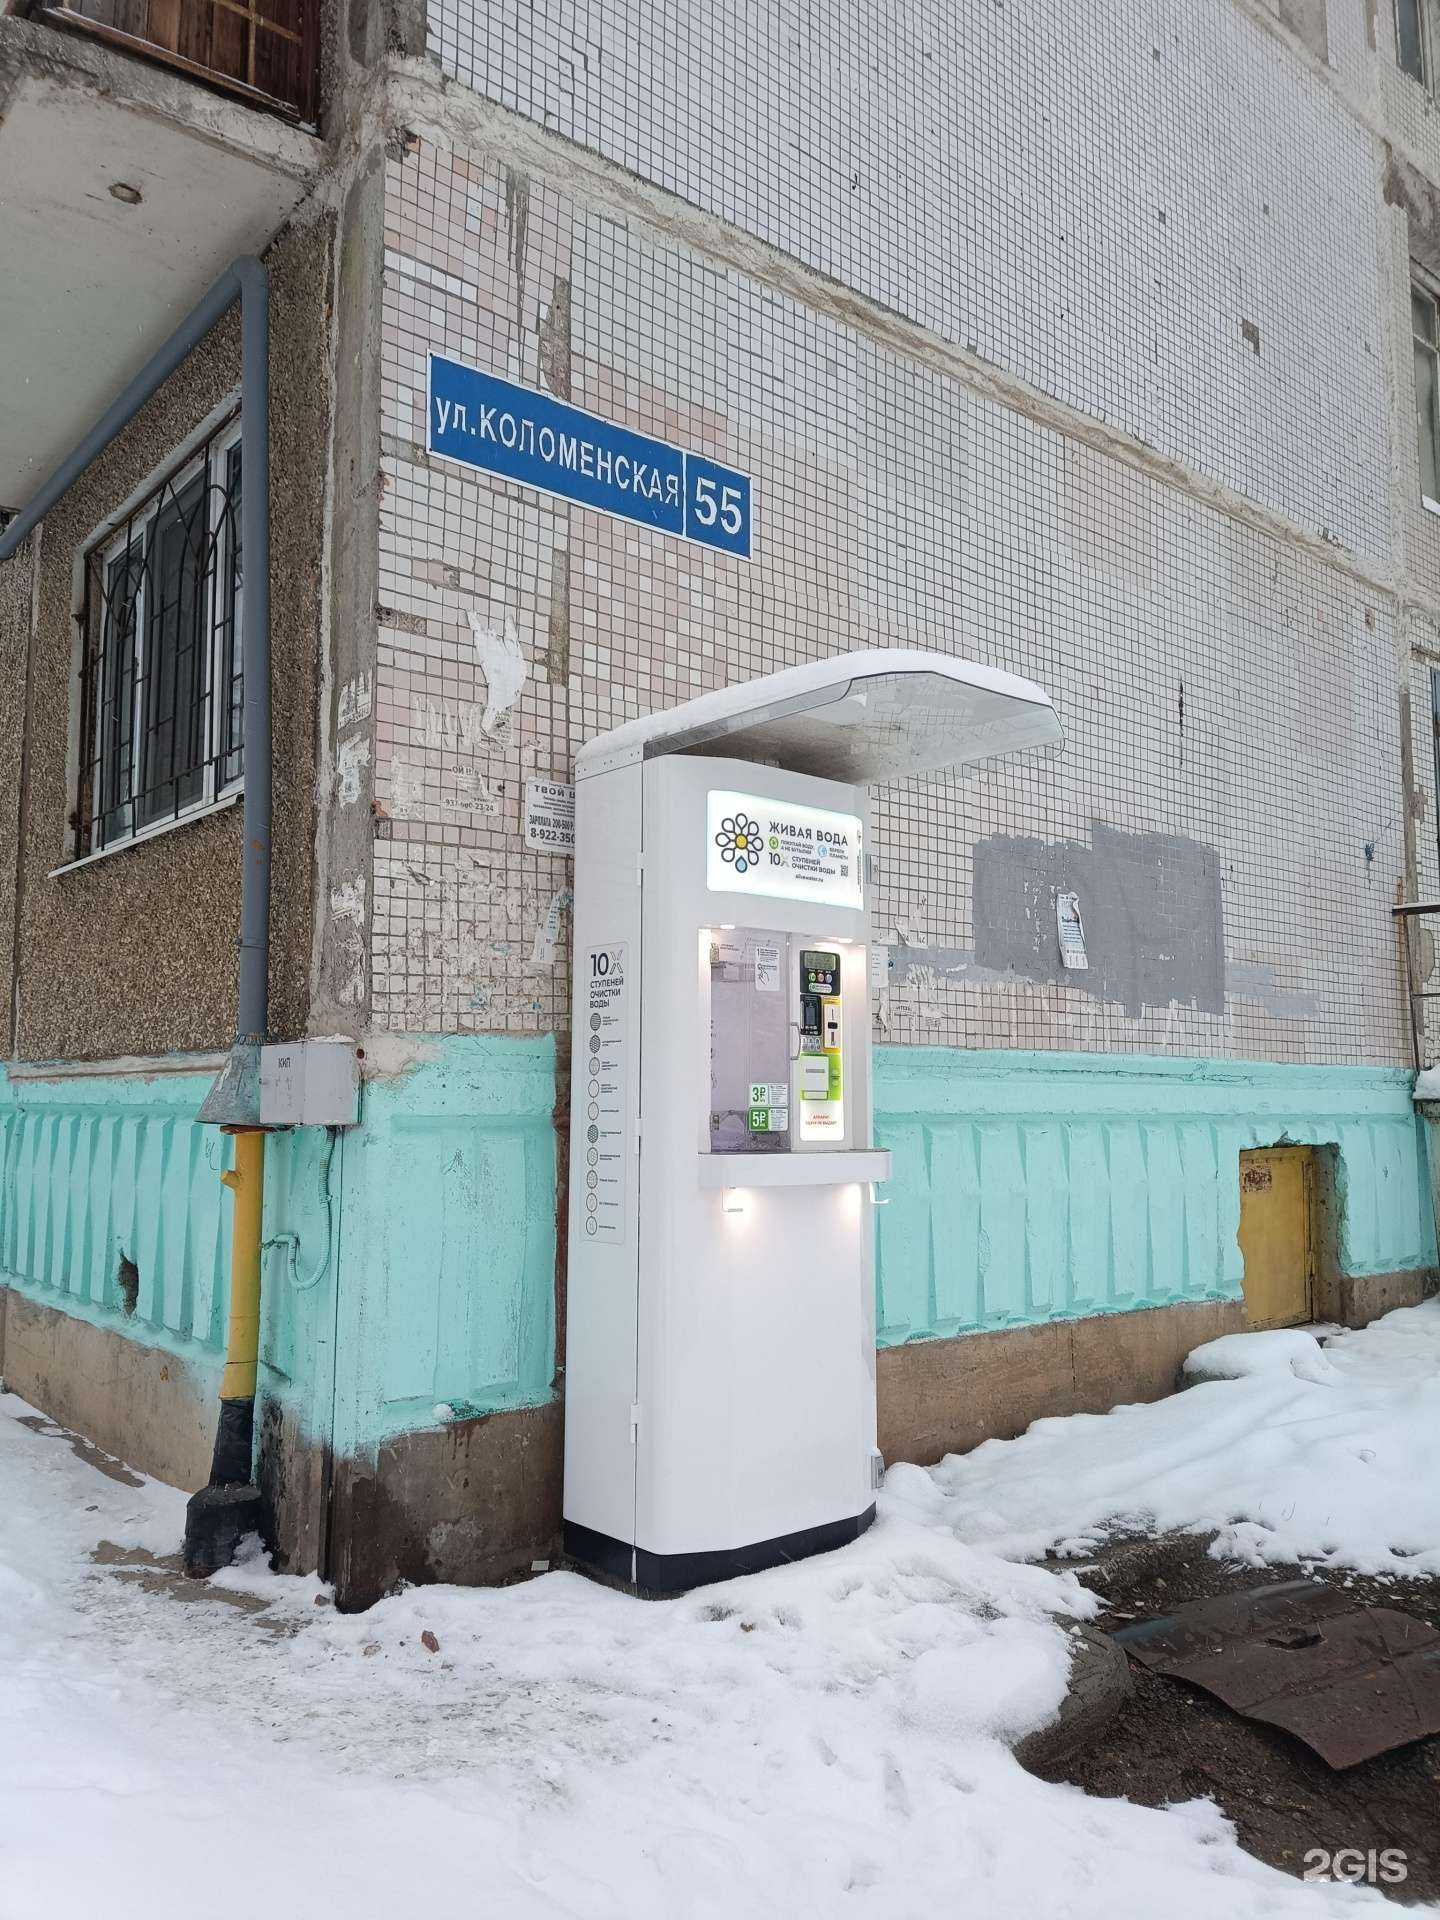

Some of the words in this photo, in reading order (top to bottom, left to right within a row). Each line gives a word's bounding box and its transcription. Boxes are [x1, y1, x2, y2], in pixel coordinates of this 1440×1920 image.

[435, 396, 680, 507] ул.КОЛОМЕНСКАЯ
[694, 476, 743, 536] 55
[534, 784, 565, 797] ТВОЙ
[769, 820, 812, 840] ЖИВАЯ
[816, 829, 848, 846] ВОДА
[791, 856, 821, 866] СТУПЕНЕЙ
[791, 863, 818, 873] ОЧИСТКИ
[818, 867, 836, 875] ВОДЫ
[590, 976, 624, 988] СТУПЕНЕЙ
[590, 988, 621, 998] ОЧИСТКИ
[589, 999, 610, 1008] ВОДЫ
